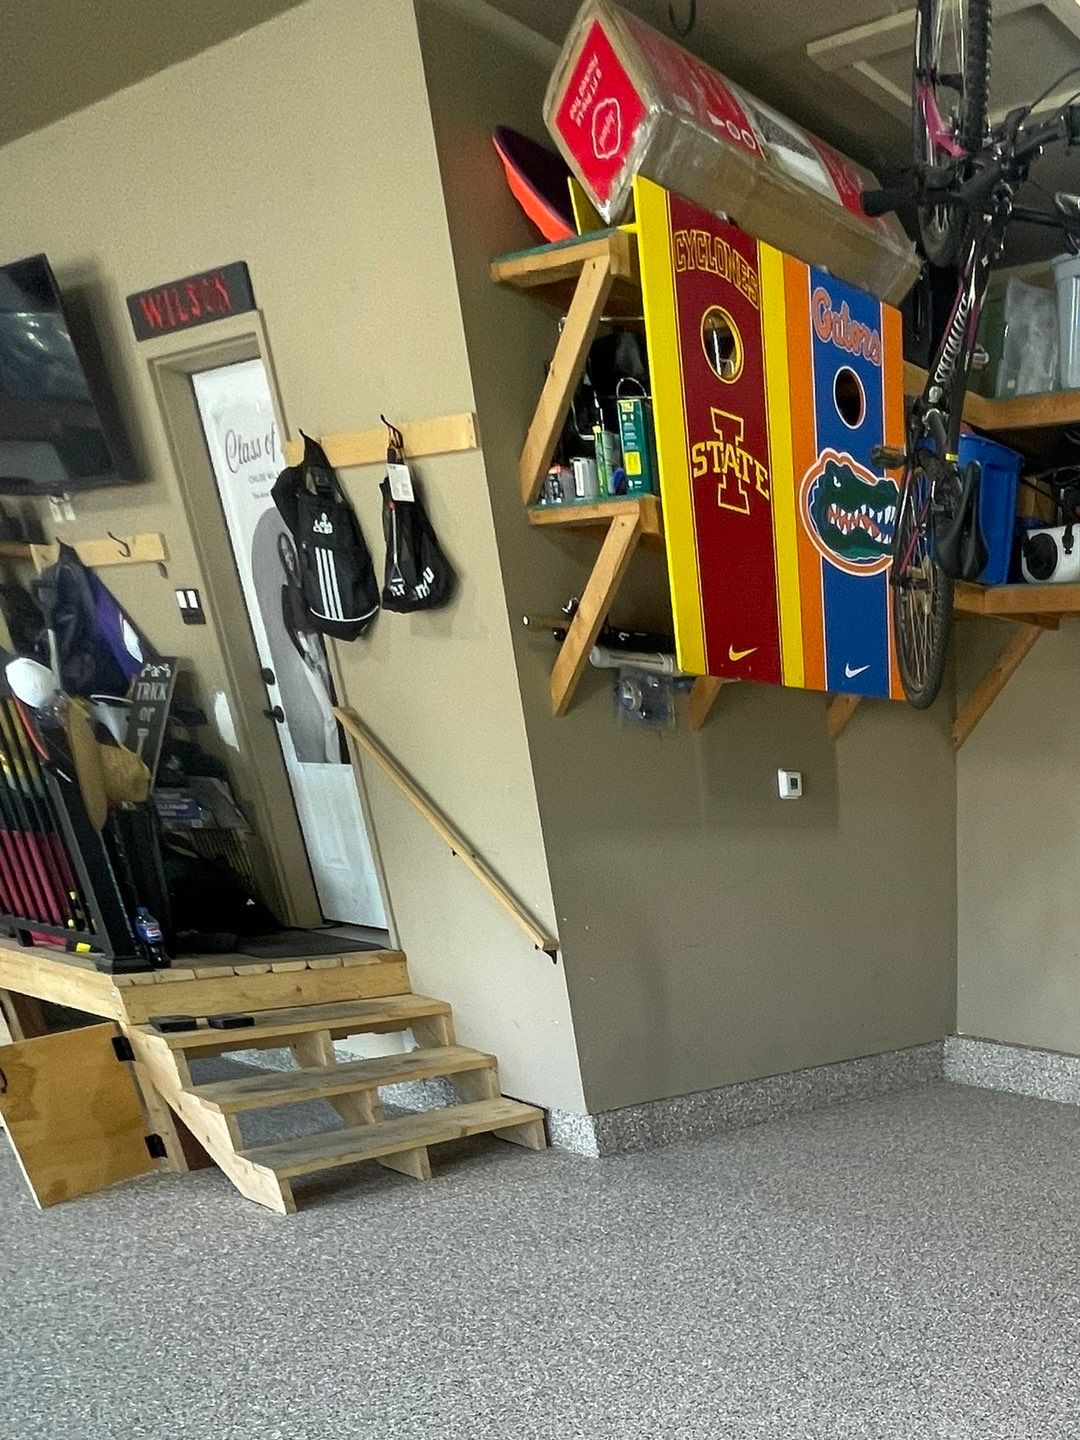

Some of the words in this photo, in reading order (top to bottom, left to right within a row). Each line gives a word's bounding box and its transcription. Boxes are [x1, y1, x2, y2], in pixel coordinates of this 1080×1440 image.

[674, 229, 759, 311] CYCLONES
[813, 286, 881, 366] Gators
[225, 428, 262, 474] Class
[265, 421, 276, 463] of
[691, 440, 770, 500] STATE
[140, 706, 156, 722] or
